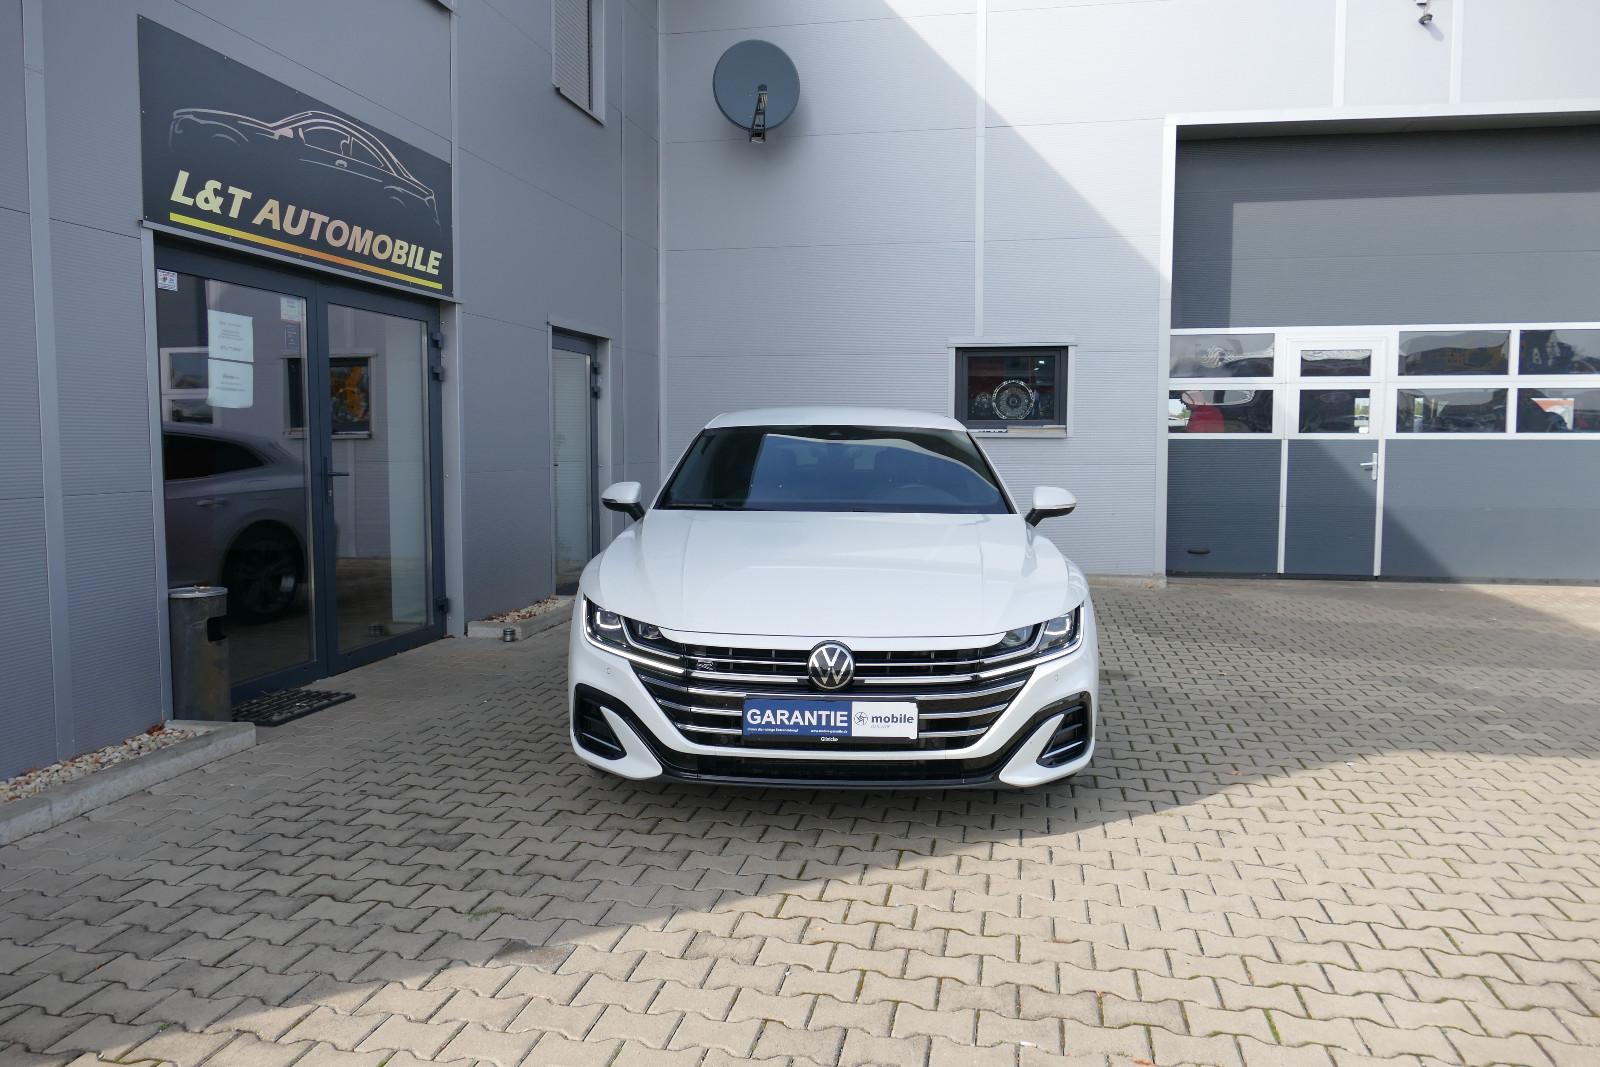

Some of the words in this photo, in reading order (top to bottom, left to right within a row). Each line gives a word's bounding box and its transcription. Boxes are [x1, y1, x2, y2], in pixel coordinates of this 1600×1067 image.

[170, 169, 252, 219] L&T
[252, 199, 442, 275] AUTOMOBILE
[746, 709, 848, 727] GARANTIE
[871, 713, 914, 724] mobile
